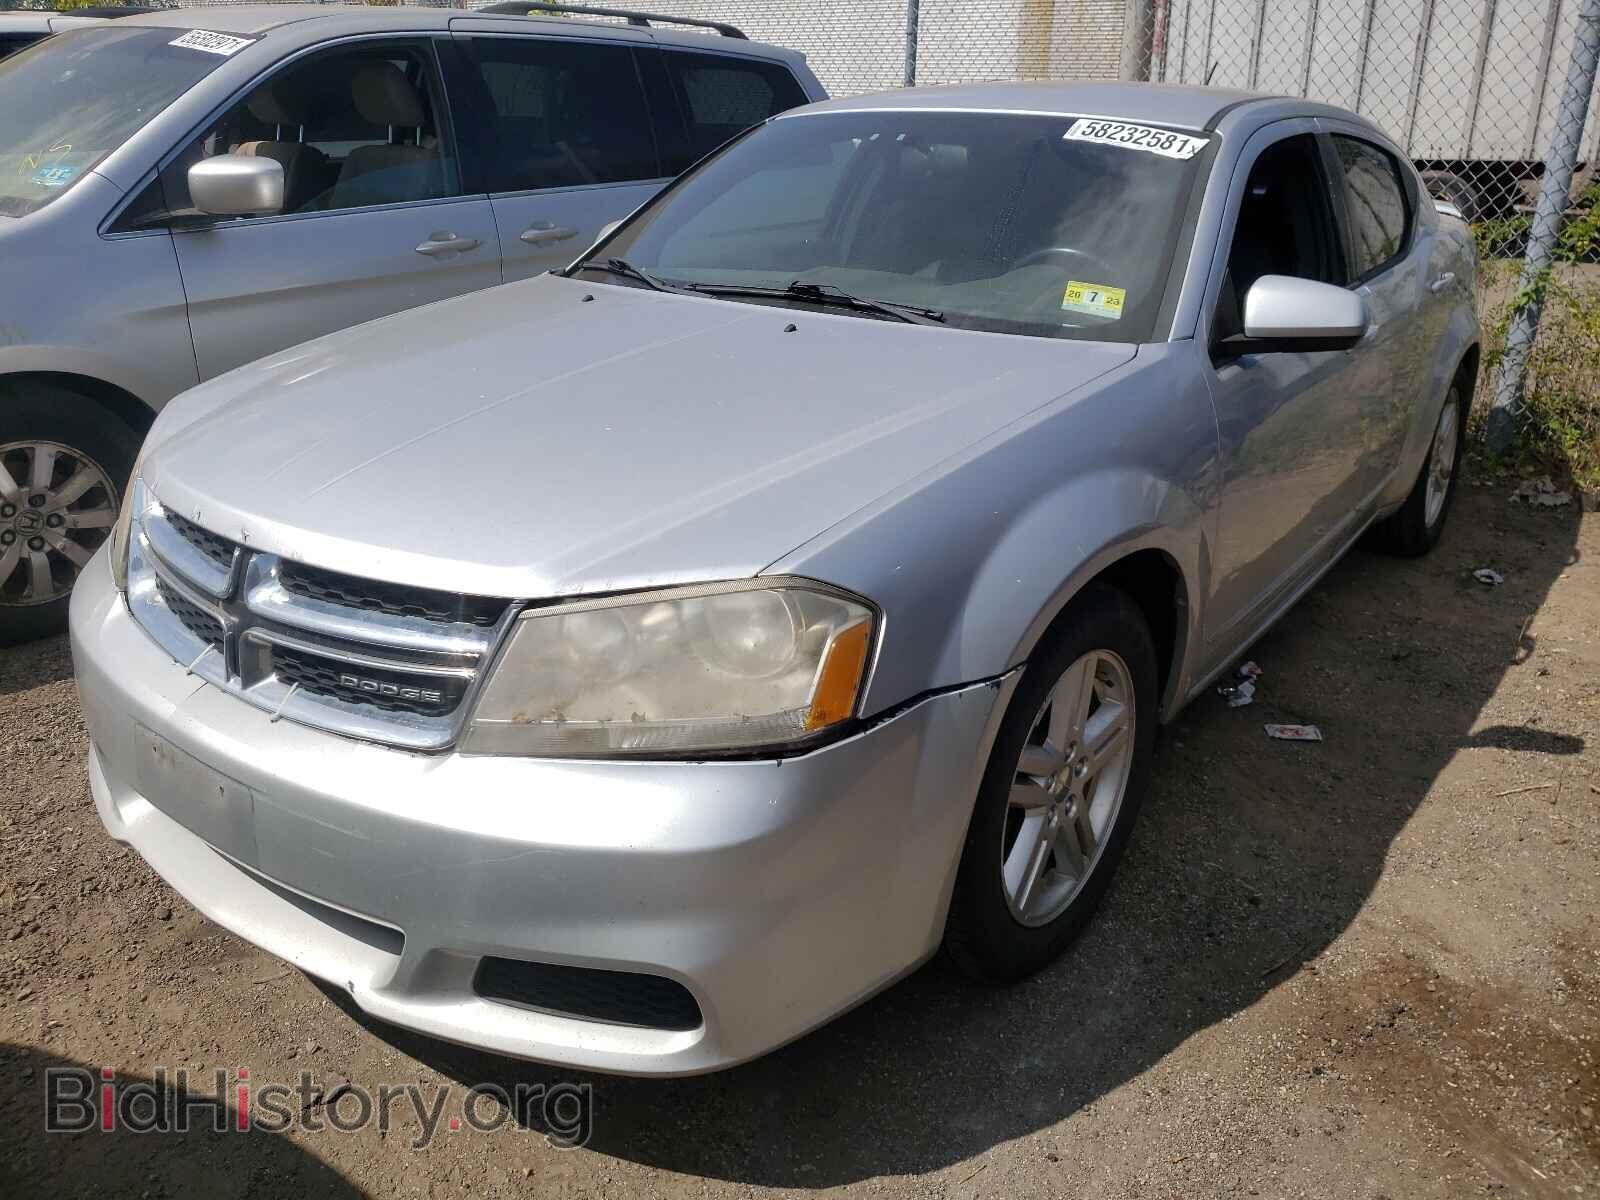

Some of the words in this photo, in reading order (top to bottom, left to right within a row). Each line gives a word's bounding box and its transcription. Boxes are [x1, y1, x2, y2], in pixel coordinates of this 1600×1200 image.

[1081, 121, 1190, 153] 58232581
[1087, 291, 1099, 303] 7
[339, 674, 441, 703] DODGE
